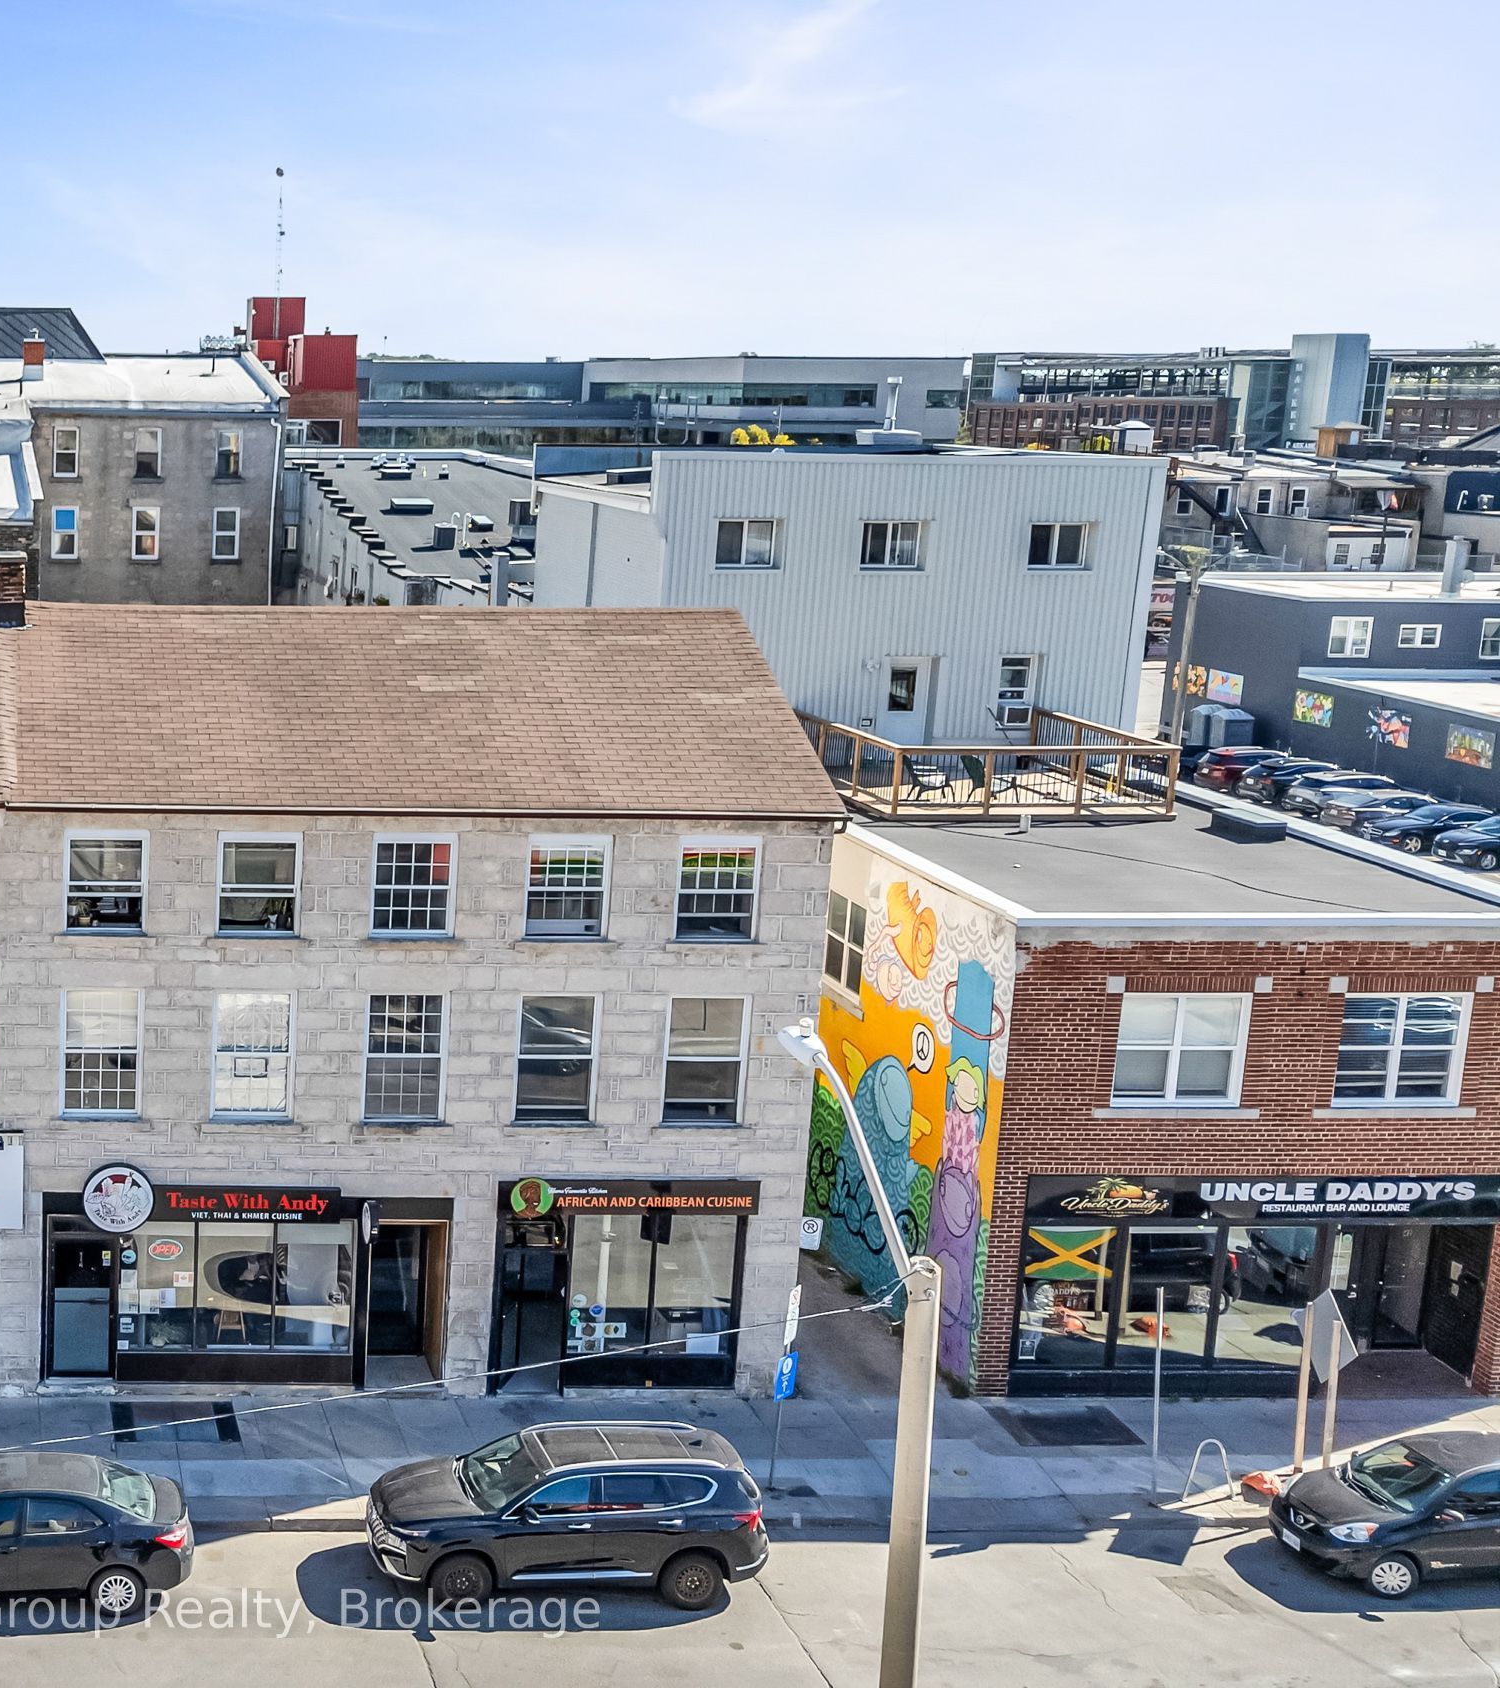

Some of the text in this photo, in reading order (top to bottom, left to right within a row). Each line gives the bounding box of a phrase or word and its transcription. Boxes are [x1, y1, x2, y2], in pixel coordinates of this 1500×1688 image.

[1200, 1182, 1476, 1201] UNCLE DADDY'S
[166, 1191, 329, 1215] Taste With Andy
[556, 1196, 752, 1208] AFRICAN AND CARIBBEAN CUISINE
[1060, 1197, 1109, 1211] Uncle
[1262, 1203, 1411, 1213] RESTAURANT BAR AND LOUNGE
[110, 1216, 126, 1225] With
[191, 1211, 303, 1221] VIET, THAI & KHMER CUISINE
